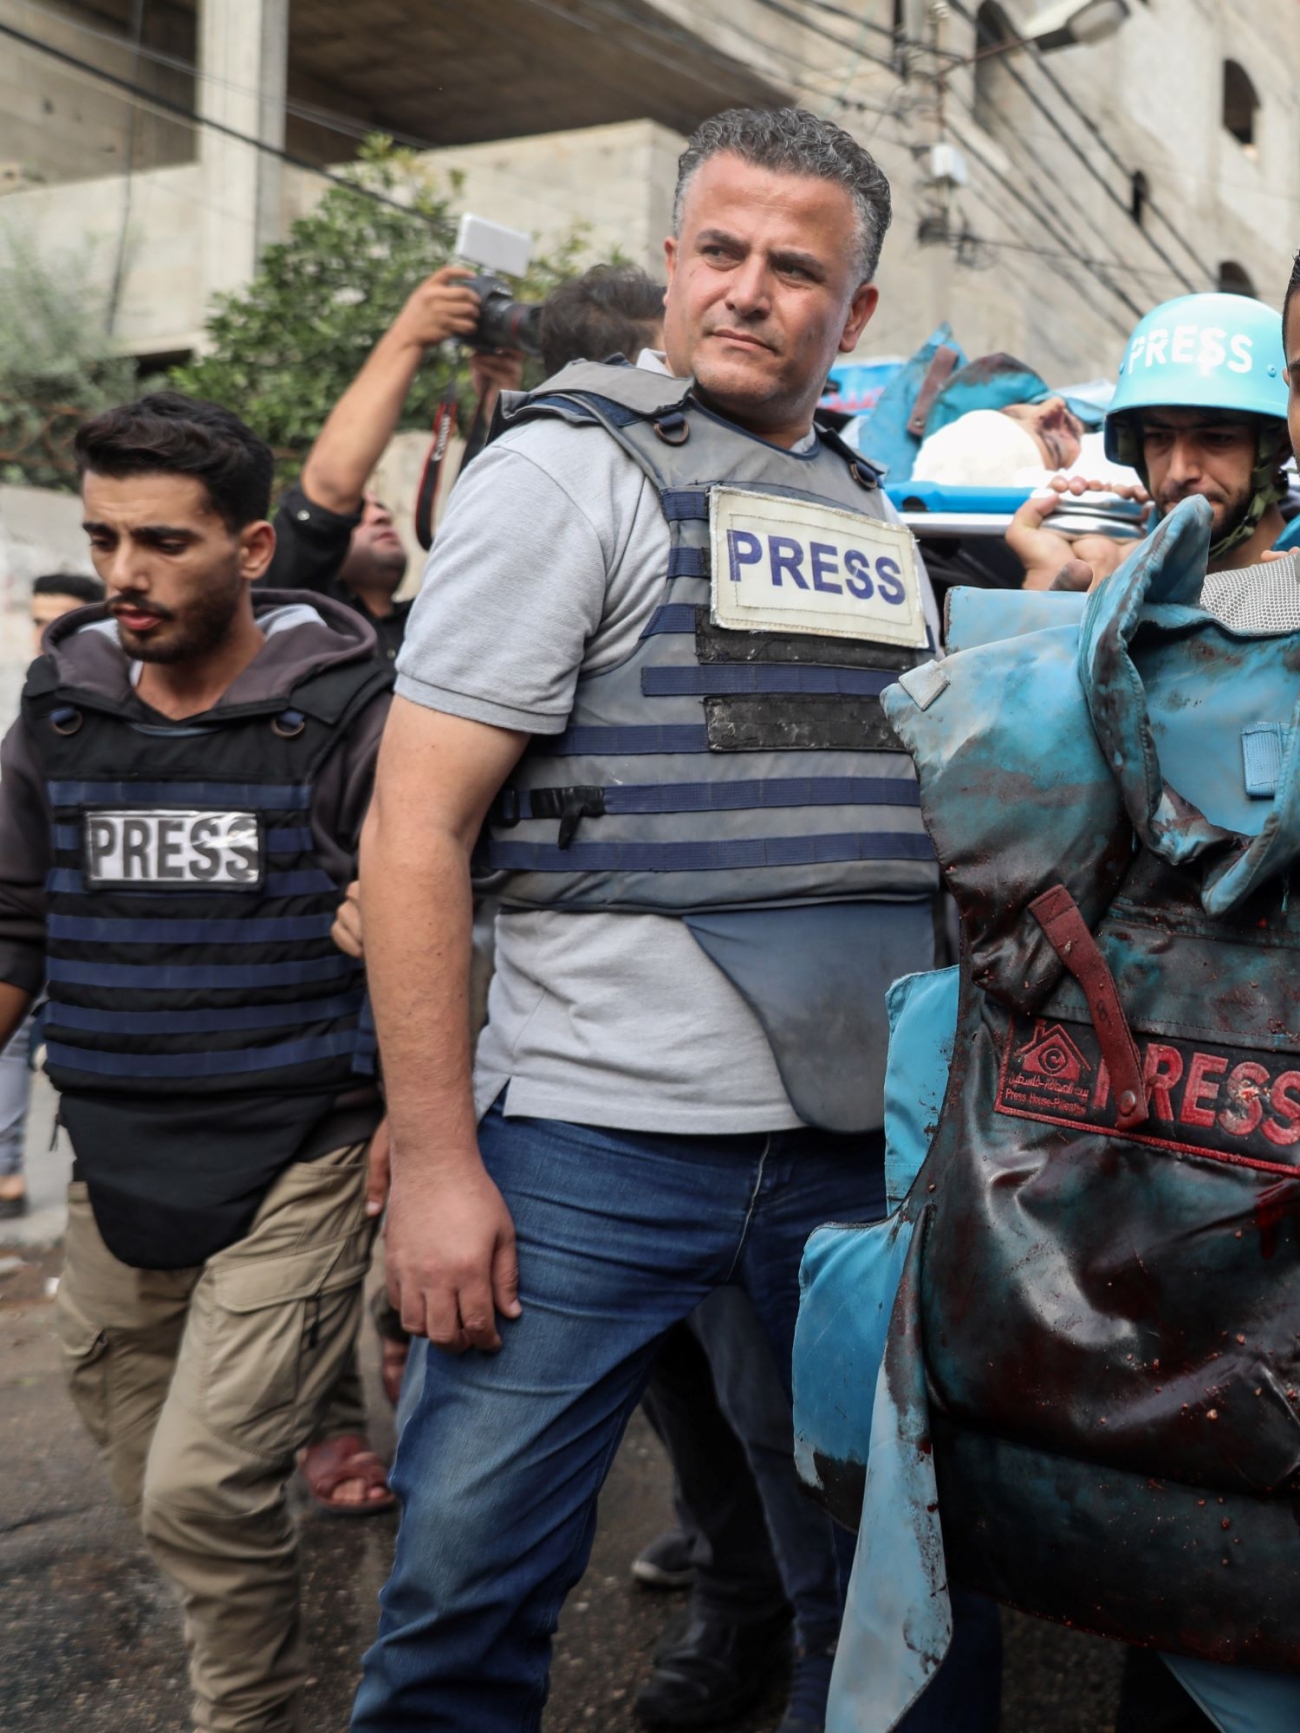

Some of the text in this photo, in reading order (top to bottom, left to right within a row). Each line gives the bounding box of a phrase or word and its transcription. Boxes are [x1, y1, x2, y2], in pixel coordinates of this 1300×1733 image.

[1127, 325, 1253, 374] PRESS
[727, 529, 906, 605] PRESS
[90, 817, 259, 880] PRESS
[1005, 1087, 1027, 1102] Press
